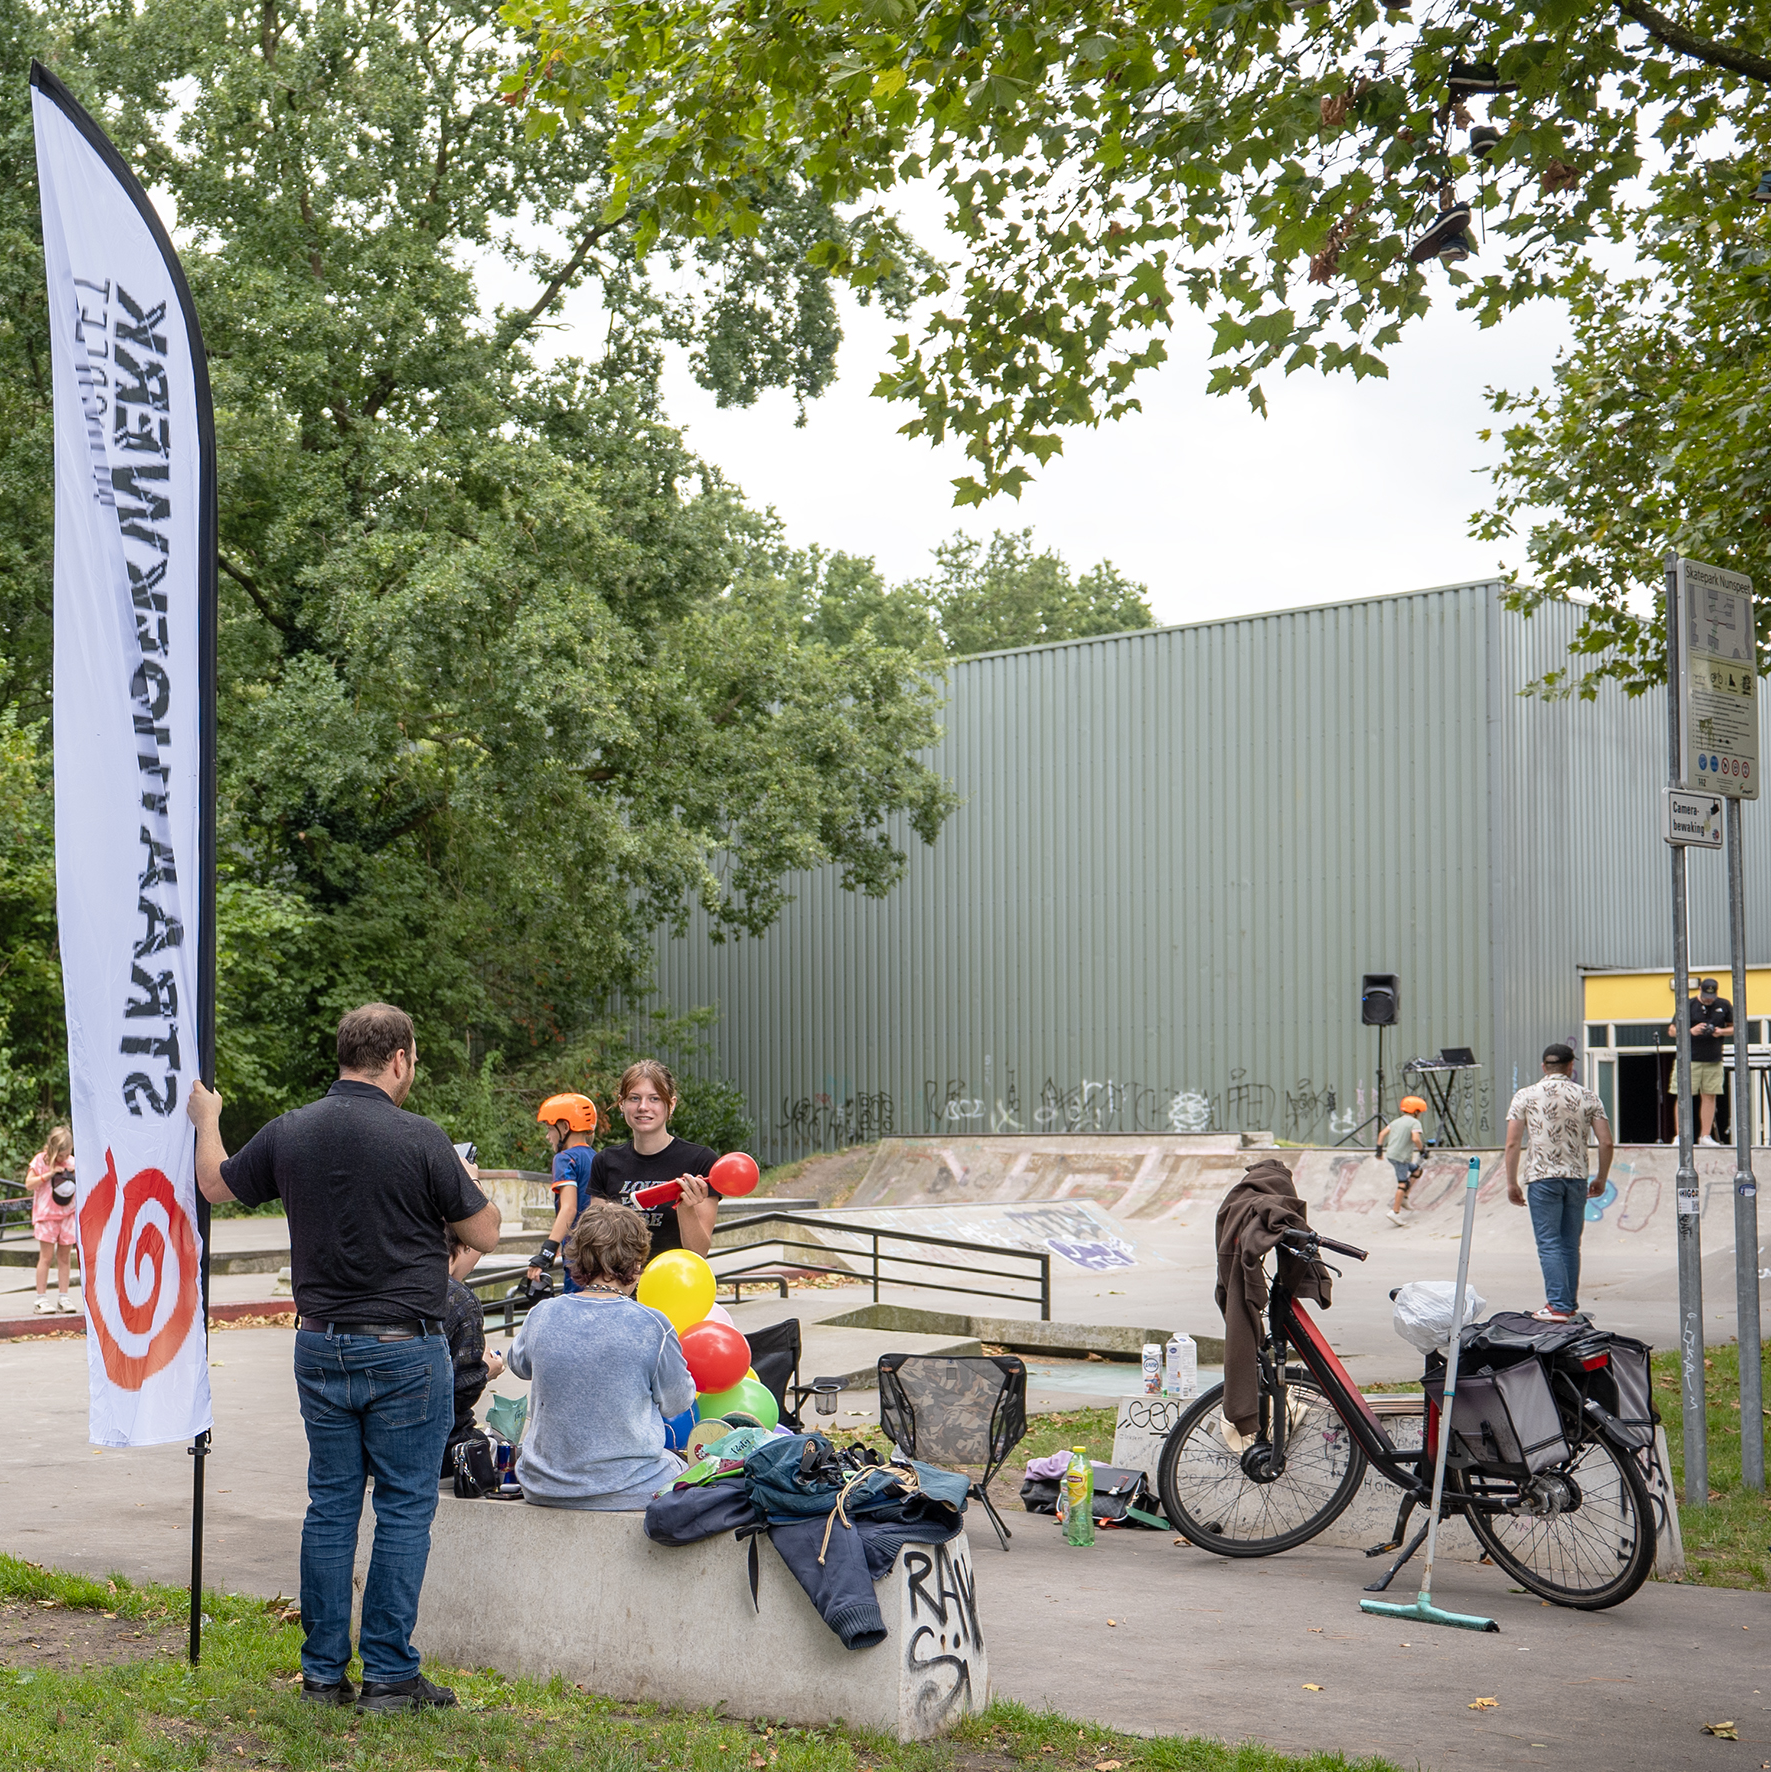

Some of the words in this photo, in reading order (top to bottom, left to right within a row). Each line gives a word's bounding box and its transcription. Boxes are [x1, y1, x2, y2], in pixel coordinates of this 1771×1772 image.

[1685, 565, 1719, 586] Skatepark
[1719, 575, 1752, 595] Nunspeet
[1673, 801, 1700, 816] Camera-
[1673, 819, 1705, 837] bewaking
